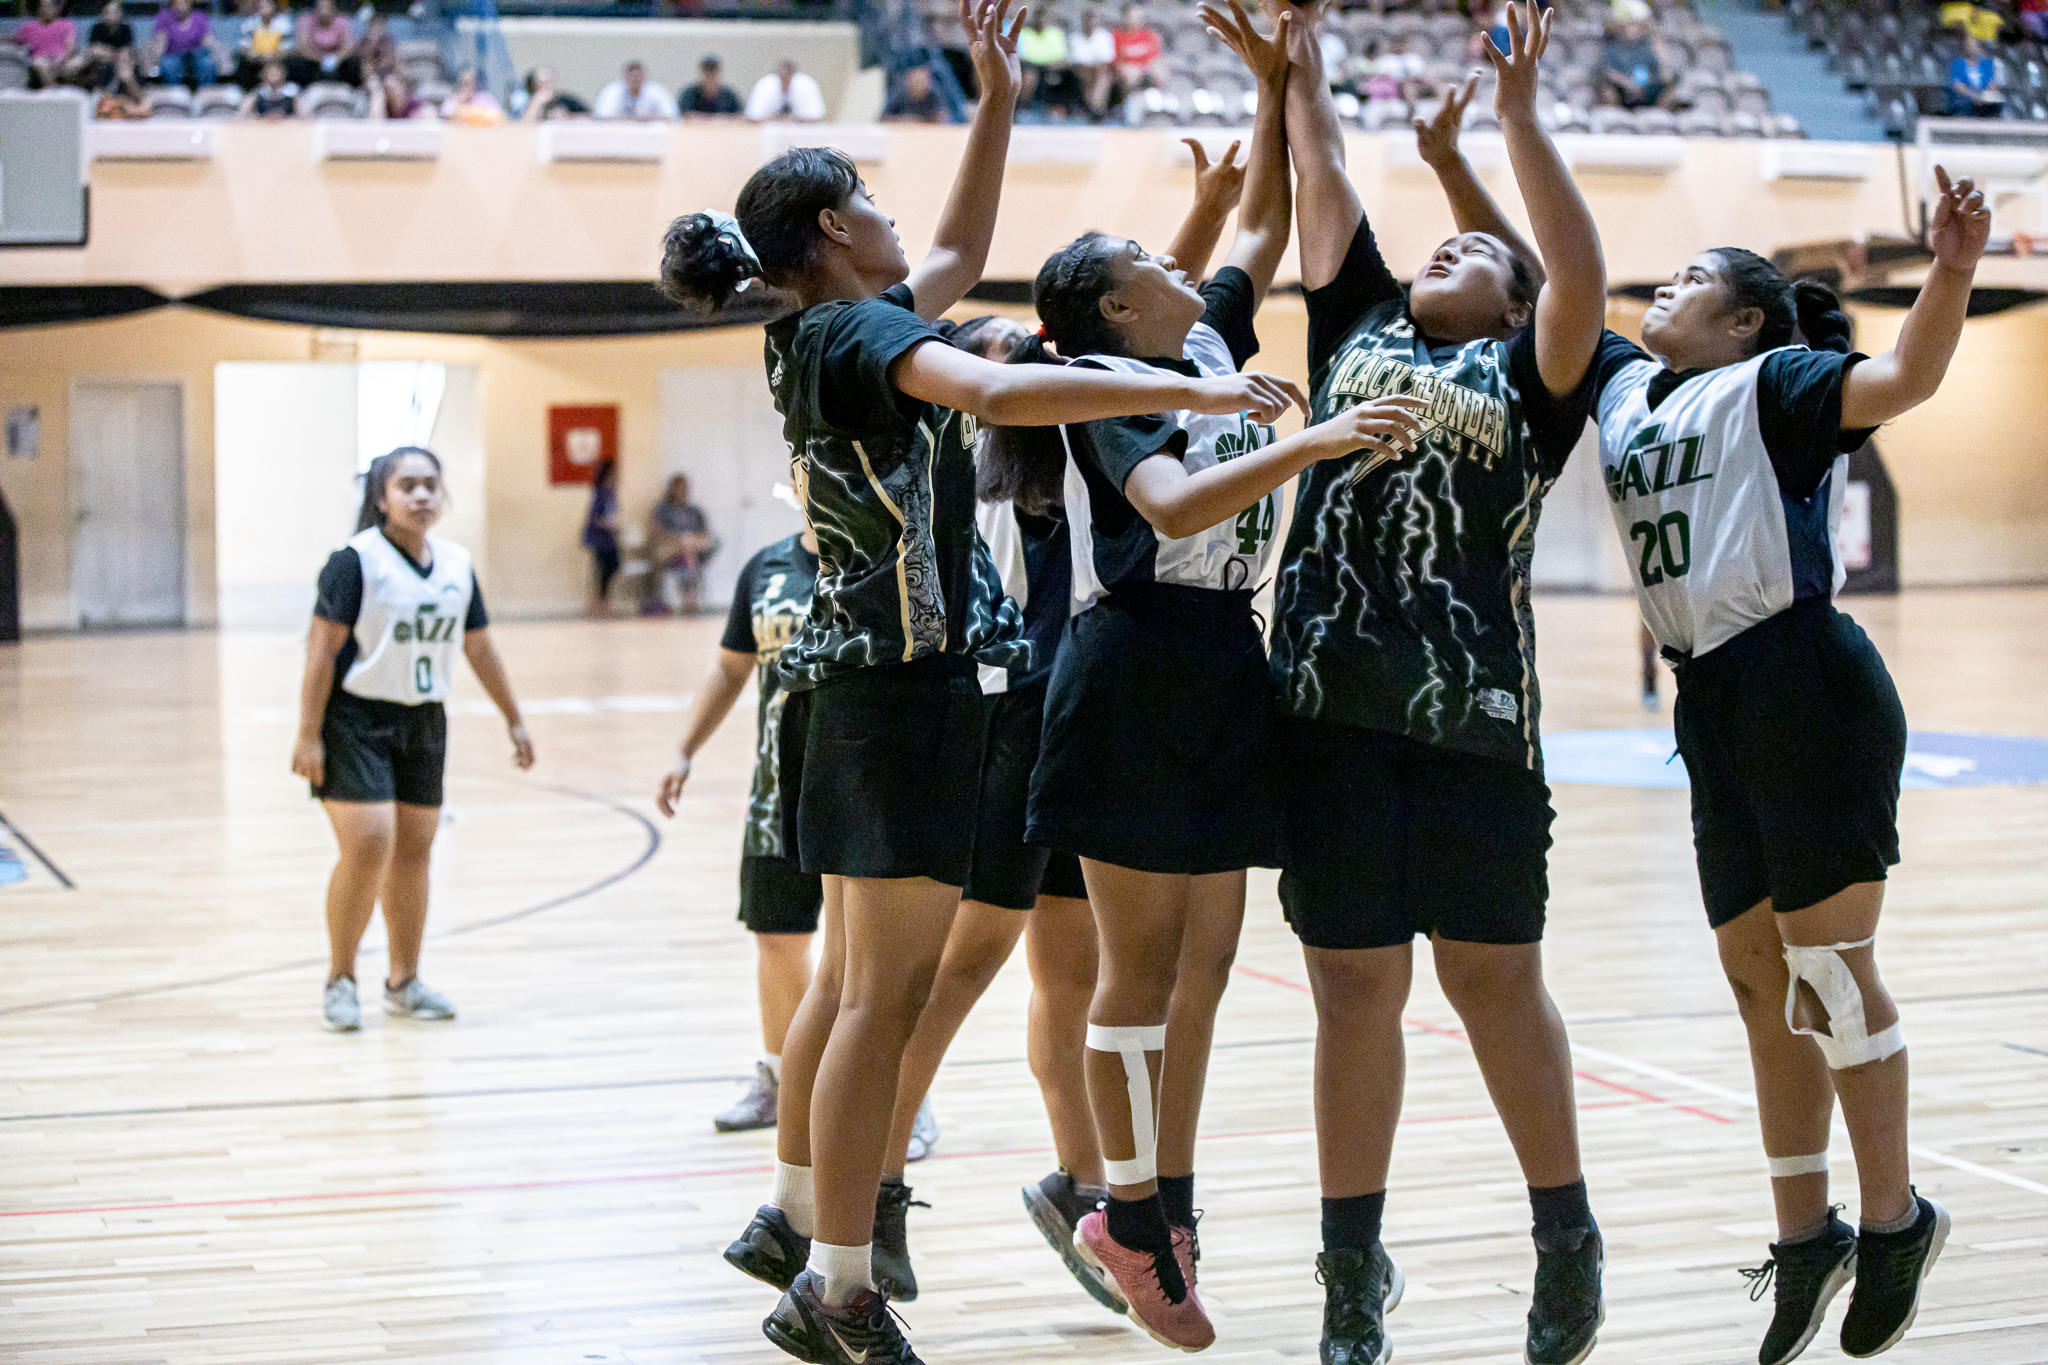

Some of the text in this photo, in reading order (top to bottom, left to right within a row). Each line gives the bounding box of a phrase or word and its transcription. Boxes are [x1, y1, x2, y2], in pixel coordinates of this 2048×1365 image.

[1327, 347, 1507, 459] BLACK THUNDER
[1629, 510, 1691, 588] 20
[415, 656, 432, 694] 0
